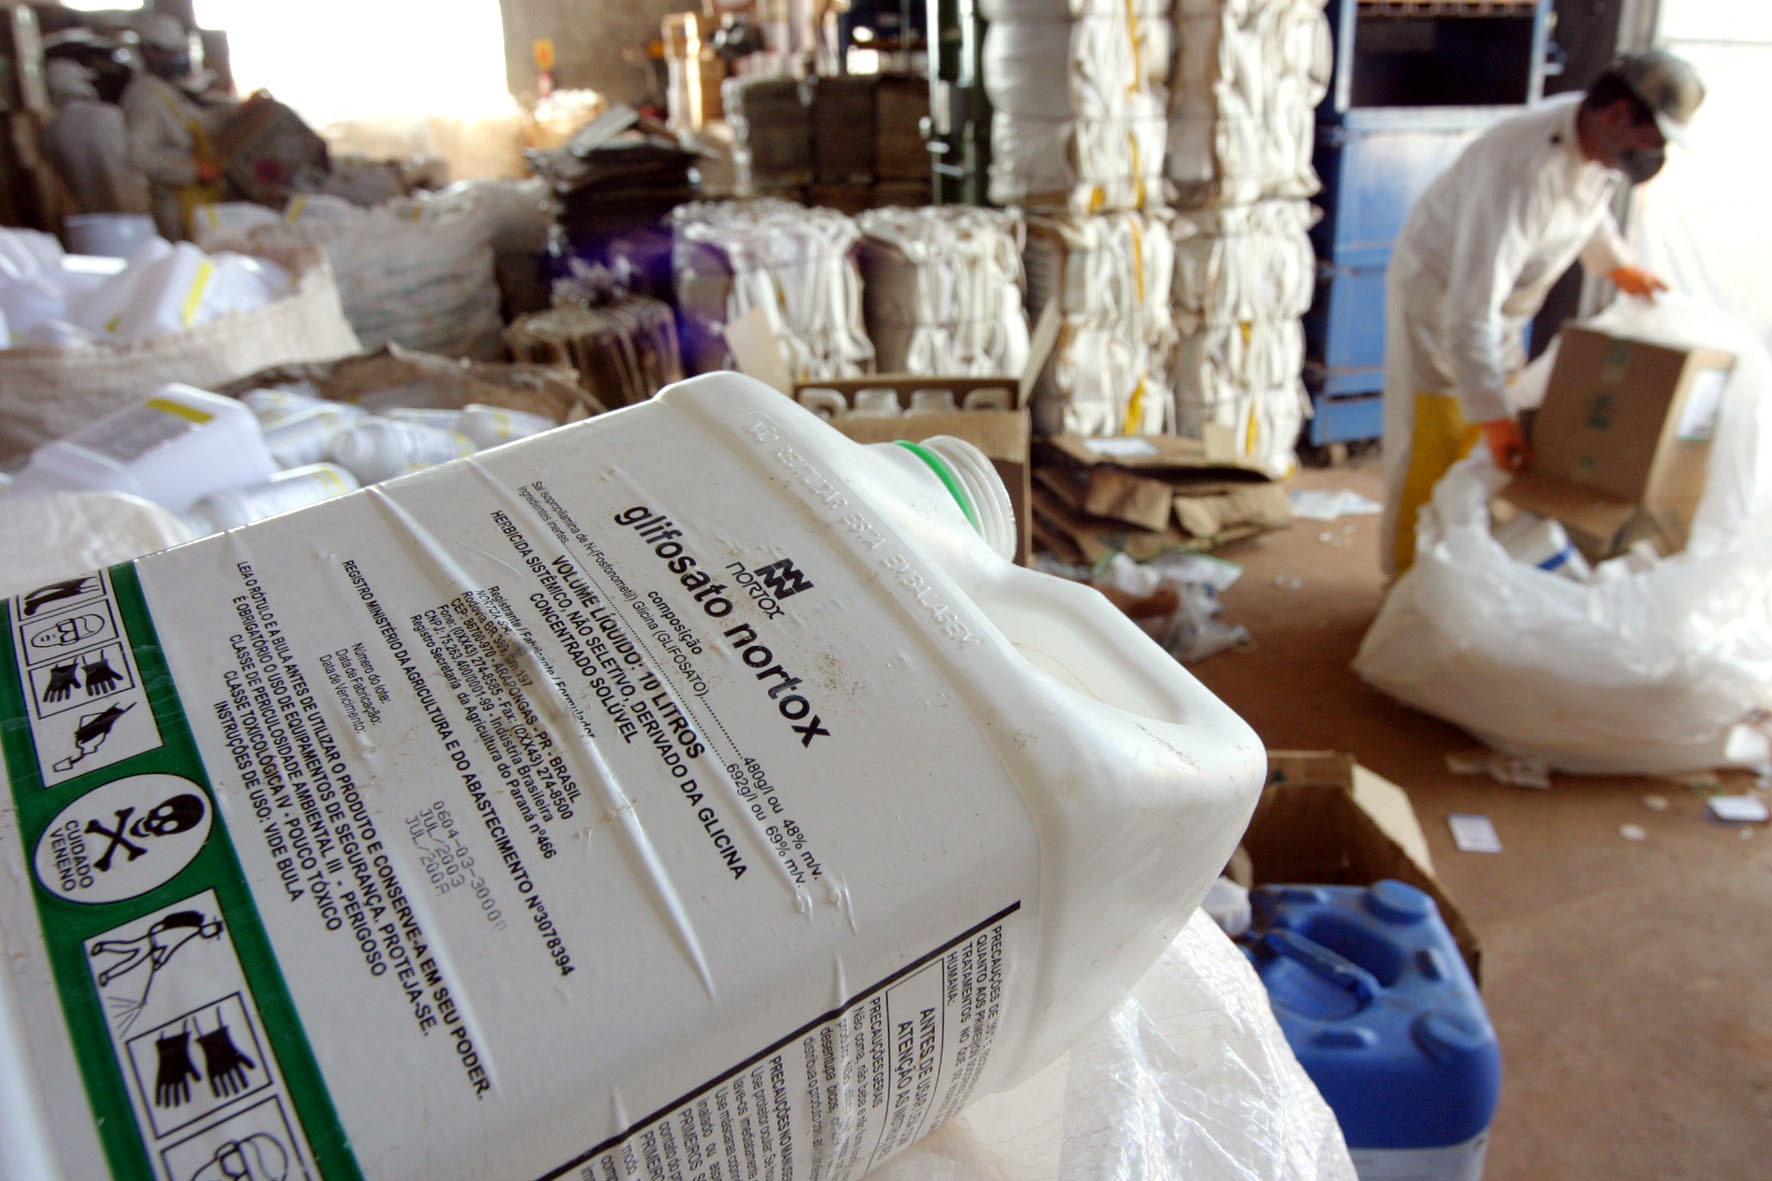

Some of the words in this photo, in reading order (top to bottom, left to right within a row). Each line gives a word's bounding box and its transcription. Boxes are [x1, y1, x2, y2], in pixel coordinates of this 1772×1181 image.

[237, 562, 254, 580] LEIA
[342, 560, 374, 600] REGISTRO
[233, 596, 246, 604] É
[248, 586, 274, 621] RÓTULO
[461, 591, 487, 623] Rodovia
[483, 621, 498, 637] BR
[488, 585, 522, 627] Registrante
[236, 603, 273, 663] OBRIGATÓRIO
[264, 621, 278, 629] E
[268, 630, 281, 638] A
[366, 600, 403, 650] MINISTÉRIO
[614, 506, 733, 618] glifosato
[723, 623, 831, 748] nortox
[648, 591, 703, 655] composição
[229, 634, 256, 672] CLASSE
[263, 664, 277, 673] O
[271, 636, 293, 664] BULA
[319, 654, 336, 674] Data
[335, 648, 352, 668] Data
[352, 642, 374, 674] Número
[368, 674, 381, 685] do
[394, 650, 411, 666] DA
[530, 593, 597, 677] CONCENTRADO
[589, 677, 638, 744] SOLÚVEL
[552, 555, 600, 608] VOLUME
[590, 607, 643, 670] LÍQUIDO:
[639, 671, 661, 691] 10
[651, 692, 705, 759] LITROS
[245, 671, 262, 687] DE
[267, 673, 287, 695] USO
[284, 664, 309, 696] ANTES
[328, 673, 341, 684] de
[345, 667, 357, 679] de
[491, 510, 533, 558] HERBICIDA
[526, 556, 573, 612] SISTÊMICO,
[566, 611, 593, 636] NÃO
[585, 636, 636, 702] SELETIVO,
[630, 701, 688, 778] DERIVADO
[680, 779, 704, 806] DA
[698, 807, 747, 880] GLICINA
[531, 481, 546, 492] Sal
[576, 533, 588, 543] de
[584, 542, 638, 602] N-(Fosfonometil)
[632, 601, 659, 630] Glicina
[767, 796, 783, 814] ou
[783, 820, 807, 850] 48%
[801, 851, 822, 880] m/v.
[277, 695, 295, 712] DE
[300, 696, 317, 712] DE
[334, 682, 366, 734] Vencimento:
[350, 677, 381, 726] Fabricação:
[403, 666, 453, 740] AGRICULTURA
[410, 614, 436, 648] Registro
[430, 647, 461, 690] Secretaria
[457, 692, 470, 705] da
[464, 706, 502, 762] Agricultura
[497, 763, 511, 779] do
[506, 779, 537, 822] Paraná
[424, 610, 445, 634] CNPJ:
[490, 716, 522, 765] Indústria
[517, 765, 553, 822] Brasileira
[437, 604, 457, 627] Fone:
[449, 627, 479, 657] (0XX43)
[471, 656, 503, 696] 274-8585
[498, 701, 517, 724] Fax:
[508, 724, 544, 767] (0XX43)
[536, 767, 574, 820] 274-8500
[451, 598, 468, 619] CEP:
[463, 617, 497, 658] 86700-970
[492, 663, 538, 725] ARAPONGAS
[534, 731, 552, 750] PR
[549, 756, 581, 803] BRASIL
[214, 700, 253, 770] INSTRUÇÕES
[251, 686, 303, 780] PERICULOSIDADE
[307, 711, 341, 762] UTILIZAR
[445, 739, 460, 751] E
[284, 711, 335, 801] EQUIPAMENTOS
[331, 763, 346, 774] O
[451, 750, 471, 771] DO
[224, 671, 251, 711] CLASSE
[240, 709, 285, 796] TOXICOLÓGICA
[275, 794, 293, 808] IV
[284, 817, 317, 870] POUCO
[307, 870, 342, 931] TÓXICO
[241, 770, 261, 790] DE
[249, 789, 272, 823] USO:
[292, 782, 335, 858] AMBIENTAL
[325, 802, 345, 823] DE
[336, 774, 376, 840] PRODUTO
[65, 820, 94, 888] CUIDADO
[264, 822, 288, 858] VIDE
[367, 841, 382, 854] E
[419, 808, 465, 887] JUL/2003
[462, 774, 533, 893] ABASTECIMENTO
[751, 803, 767, 821] ou
[765, 825, 791, 857] 69%
[785, 859, 806, 887] m/v.
[50, 828, 76, 891] VENENO
[276, 857, 304, 902] BULA
[326, 858, 343, 874] III
[335, 823, 386, 923] SEGURANÇA.
[373, 855, 427, 959] CONSERVE-A
[340, 891, 387, 976] PERIGOSO
[525, 895, 575, 976] Nº3078394
[378, 923, 437, 1036] PROTEJA-SE.
[420, 958, 442, 986] EM
[947, 951, 958, 1006] HUMANA:
[976, 934, 987, 983] QUANTO
[988, 925, 1002, 1003] PRECAUÇÕES
[961, 941, 973, 1023] TRATAMENTOS
[975, 986, 987, 1009] AOS
[433, 987, 459, 1025] SEU
[853, 1006, 865, 1031] Não
[988, 1003, 999, 1020] DE
[820, 1027, 836, 1081] desentupa
[855, 1032, 865, 1063] coma,
[869, 996, 885, 1073] PRECAUÇÕES
[894, 1020, 916, 1089] ATENÇÃO
[919, 1007, 935, 1059] ANTES
[959, 1026, 970, 1043] NO
[450, 1026, 490, 1099] PODER.
[751, 1065, 764, 1090] Use
[803, 1037, 817, 1080] distribua
[857, 1064, 868, 1083] não
[918, 1056, 934, 1080] DE
[715, 1087, 728, 1111] Use
[733, 1076, 748, 1116] lave-os
[769, 1055, 790, 1132] PRECAUÇÕES
[679, 1108, 703, 1171] PRIMEIROS
[697, 1099, 713, 1138] inalado
[779, 1128, 791, 1146] NO
